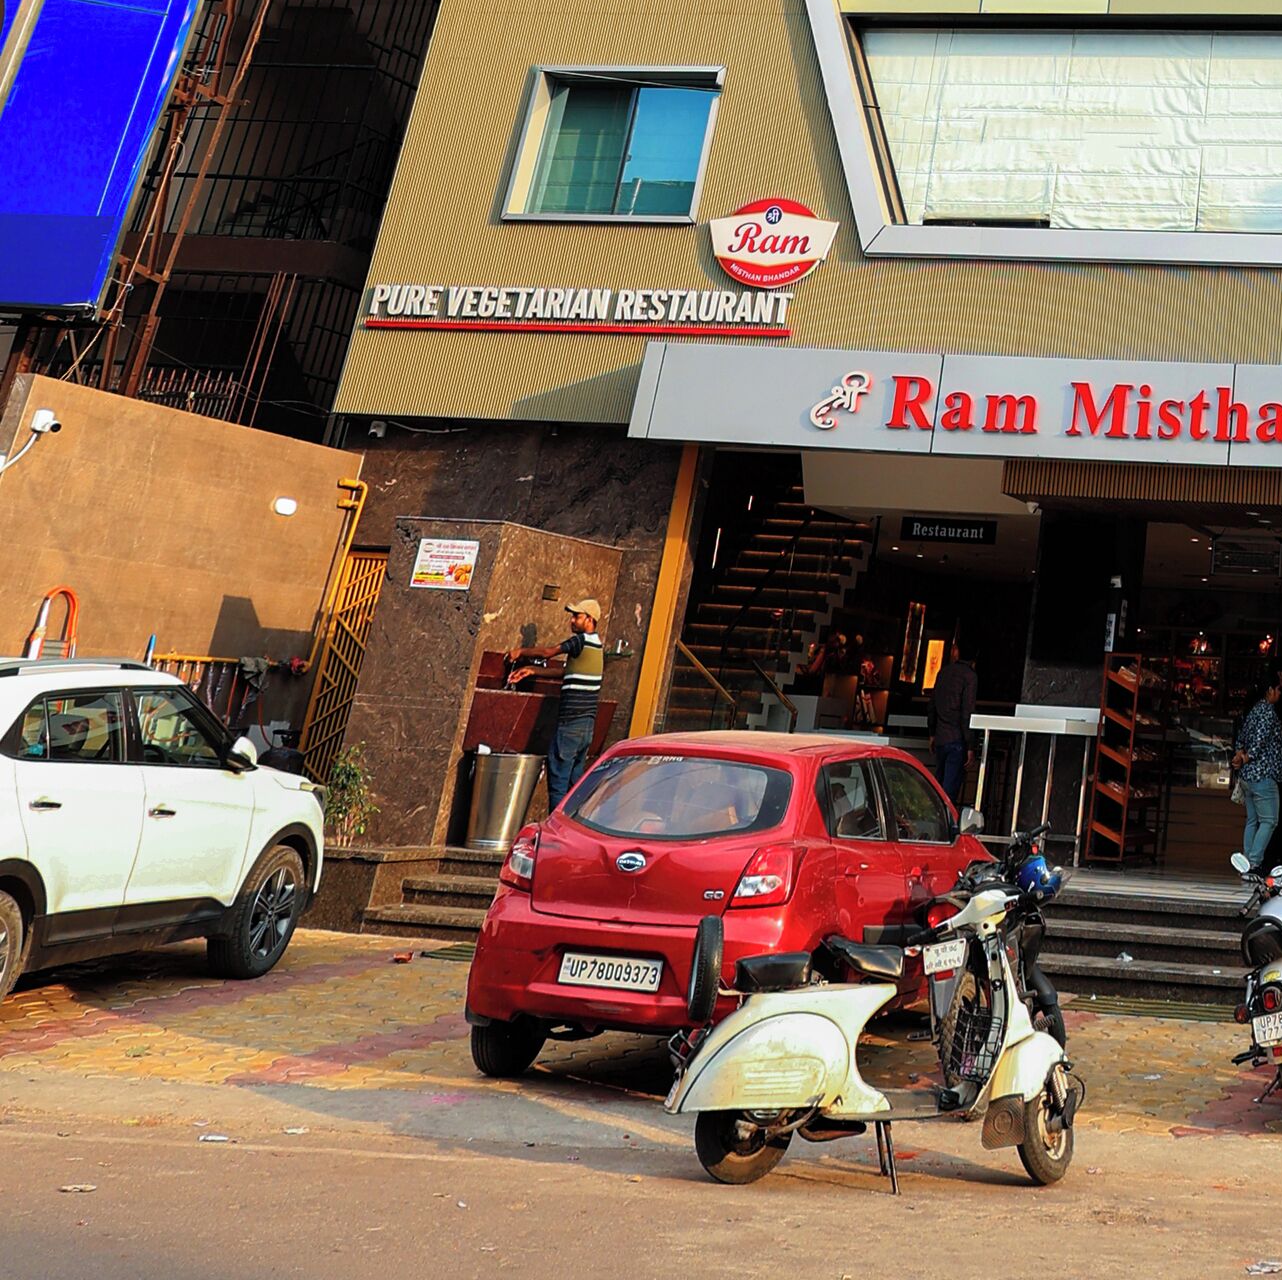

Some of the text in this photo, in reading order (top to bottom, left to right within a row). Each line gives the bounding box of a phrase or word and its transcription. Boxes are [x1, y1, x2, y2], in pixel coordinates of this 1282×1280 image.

[728, 222, 811, 255] Ram
[730, 263, 800, 282] MISTHAN BHANDAR
[370, 283, 794, 324] PURE VEGETARIAN RESTAURANT
[887, 374, 1038, 436] Ram
[912, 522, 984, 539] Restaurant
[703, 890, 725, 900] GO
